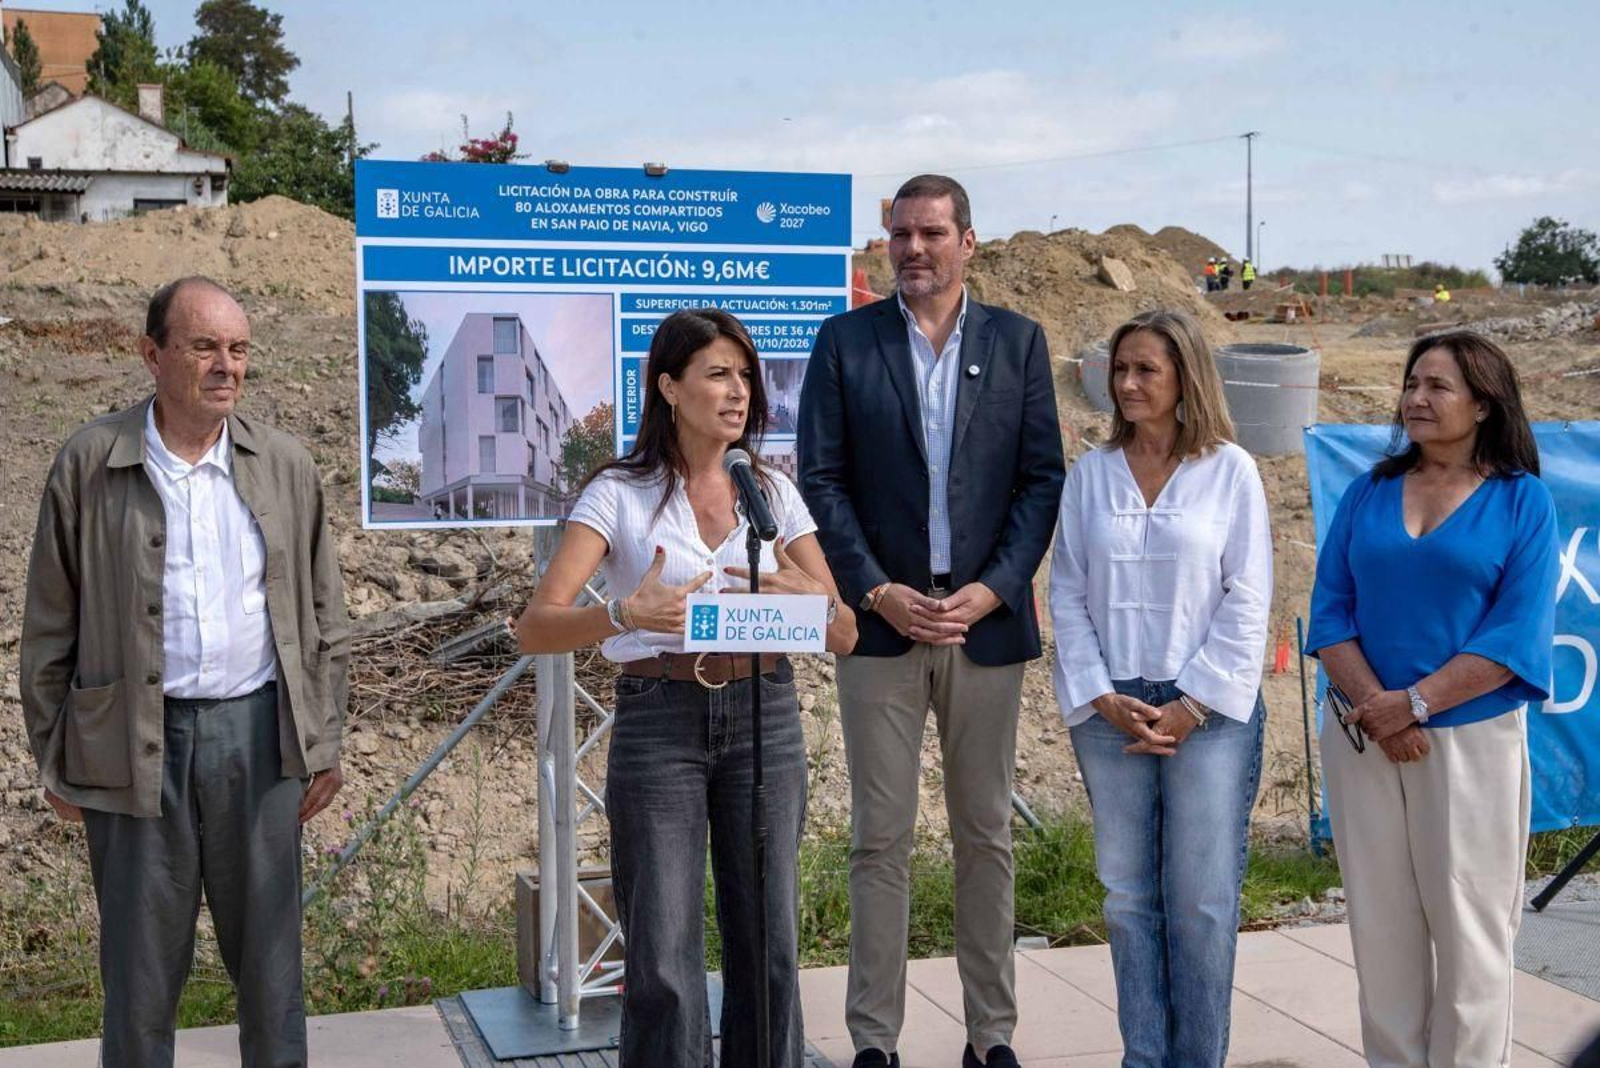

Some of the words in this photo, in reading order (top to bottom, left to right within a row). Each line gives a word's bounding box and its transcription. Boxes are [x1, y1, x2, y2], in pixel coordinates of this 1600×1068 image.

[401, 191, 450, 204] XUNTA
[498, 183, 570, 198] LICITACIÓN
[573, 187, 592, 198] DA
[595, 187, 630, 199] OBRA
[632, 188, 666, 200] PARA
[668, 188, 738, 202] CONSTRUÍR
[401, 205, 420, 218] DE
[424, 205, 480, 219] GALICIA
[515, 202, 532, 213] 80
[534, 202, 631, 216] ALOXAMENTOS
[633, 204, 723, 218] COMPARTIDOS
[779, 202, 831, 216] Xacobeo
[531, 217, 548, 230] EN
[551, 218, 577, 230] SAN
[580, 219, 610, 231] PAIO
[612, 220, 629, 231] DE
[632, 220, 675, 233] NAVIA,
[676, 221, 709, 233] VIGO
[779, 218, 804, 229] 2027
[449, 255, 555, 277] IMPORTE
[562, 253, 696, 278] LICITACIÓN:
[702, 260, 770, 282] 9,6M€
[635, 298, 699, 310] SUPERFICIE
[702, 300, 718, 310] DA
[720, 298, 789, 310] ACTUACIÓN:
[773, 325, 788, 336] DE
[790, 325, 804, 336] 36
[626, 368, 637, 424] INTERIOR
[725, 608, 784, 622] XUNTA
[725, 626, 747, 640] DE
[752, 626, 820, 641] GALICIA
